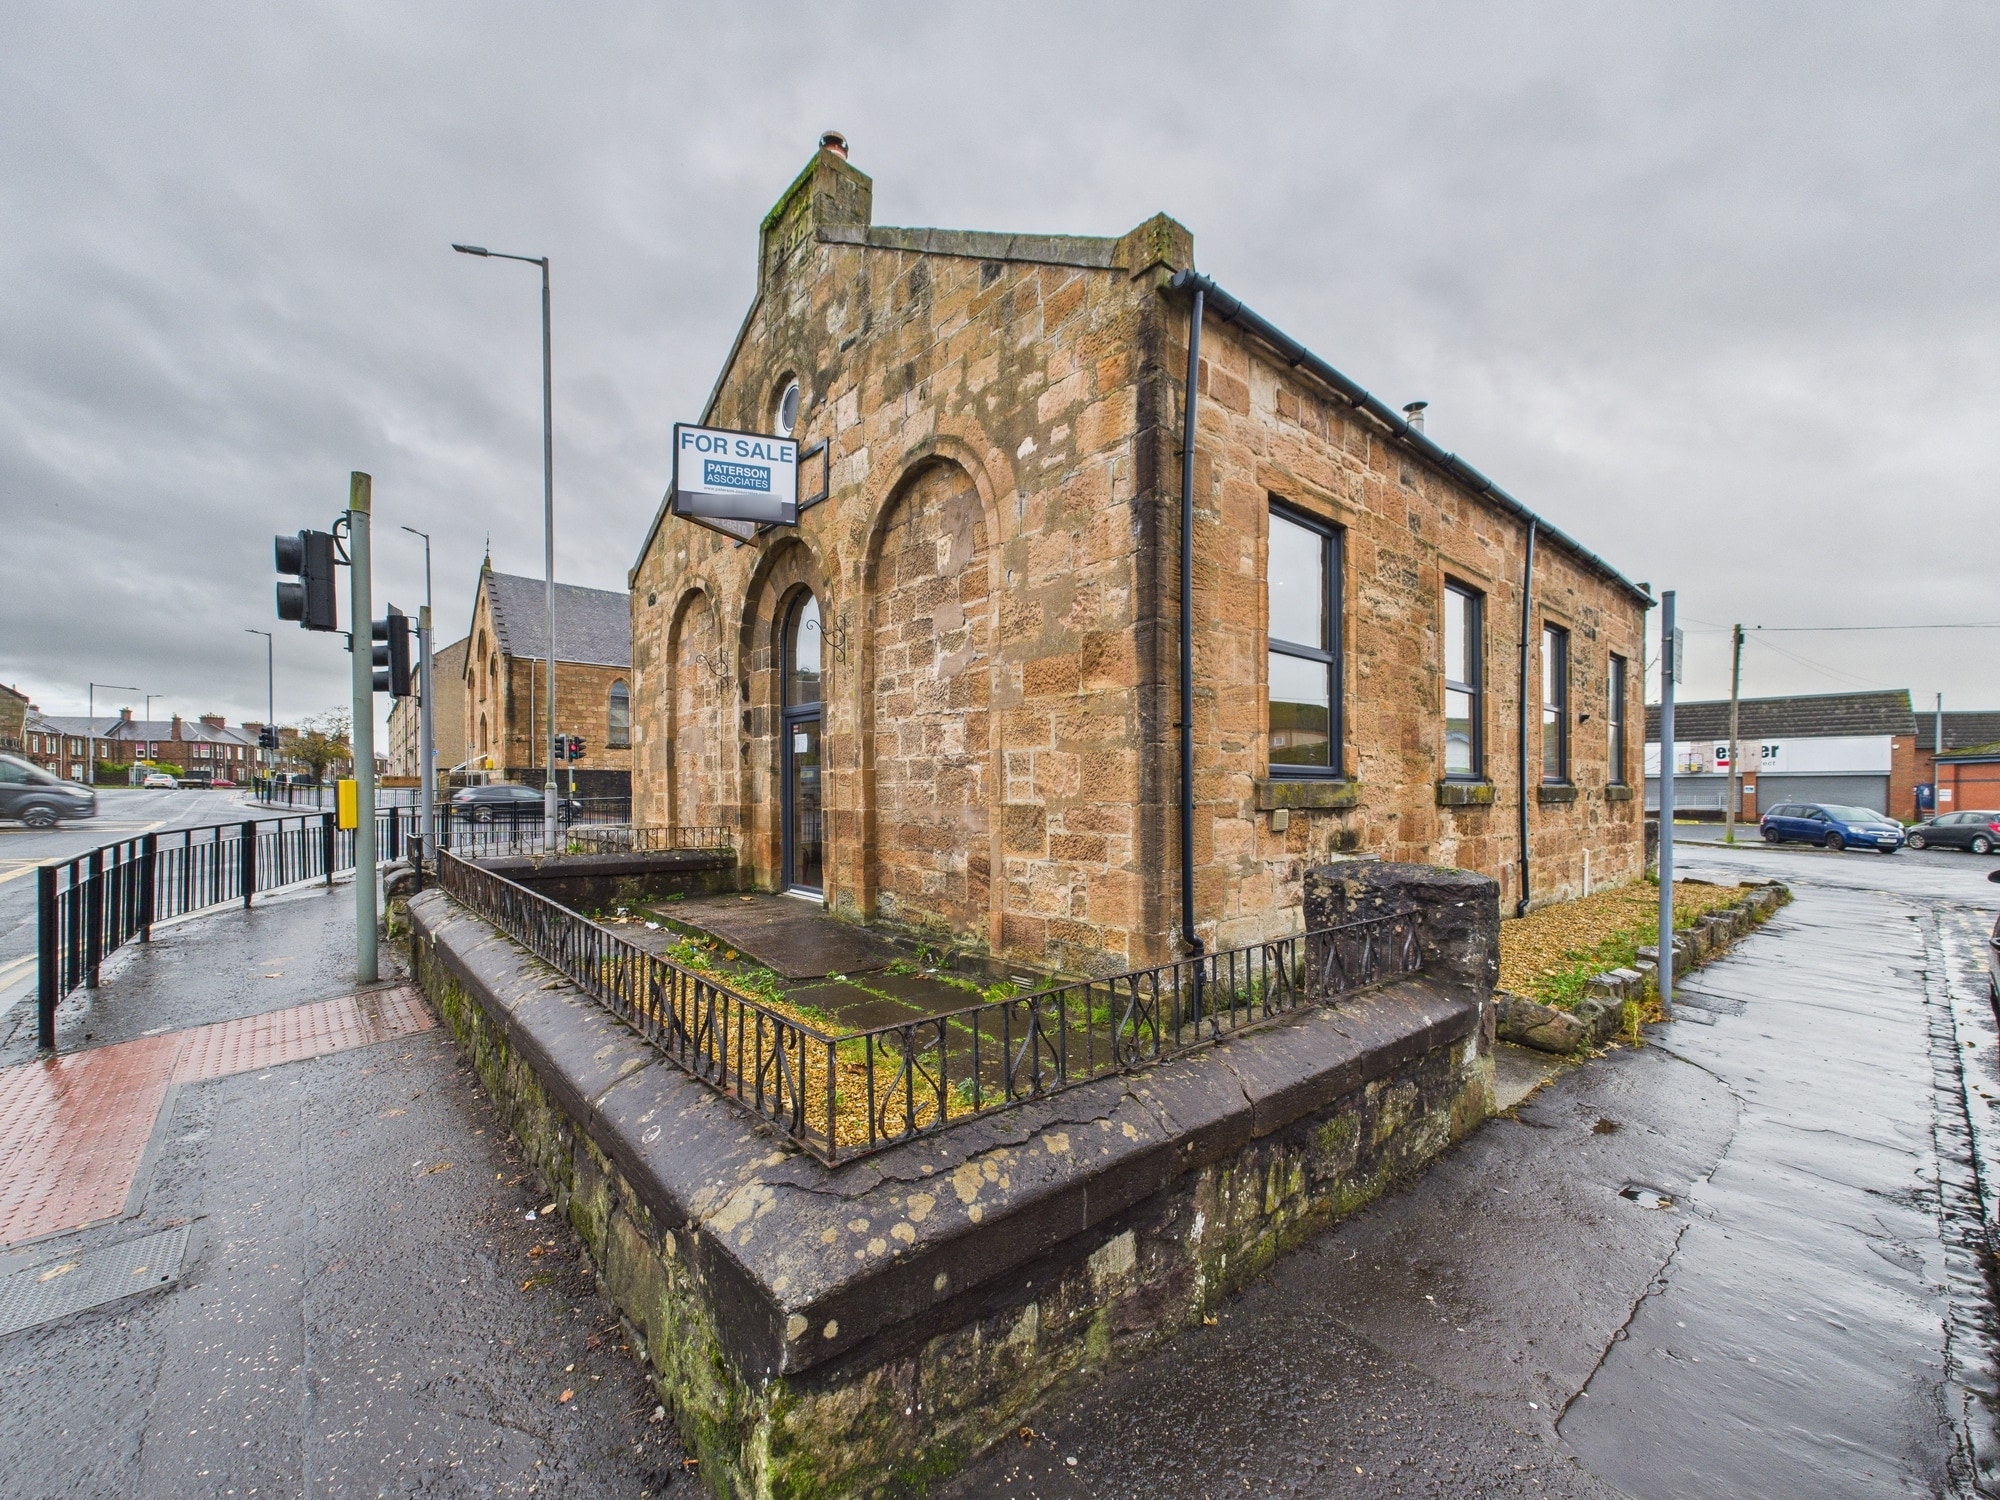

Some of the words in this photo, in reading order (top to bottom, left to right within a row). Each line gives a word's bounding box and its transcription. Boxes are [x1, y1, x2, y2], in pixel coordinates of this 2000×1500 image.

[681, 432, 728, 455] FOR
[735, 440, 793, 463] SALE
[707, 463, 768, 479] PATERSON
[706, 474, 769, 489] ASSOCIATES
